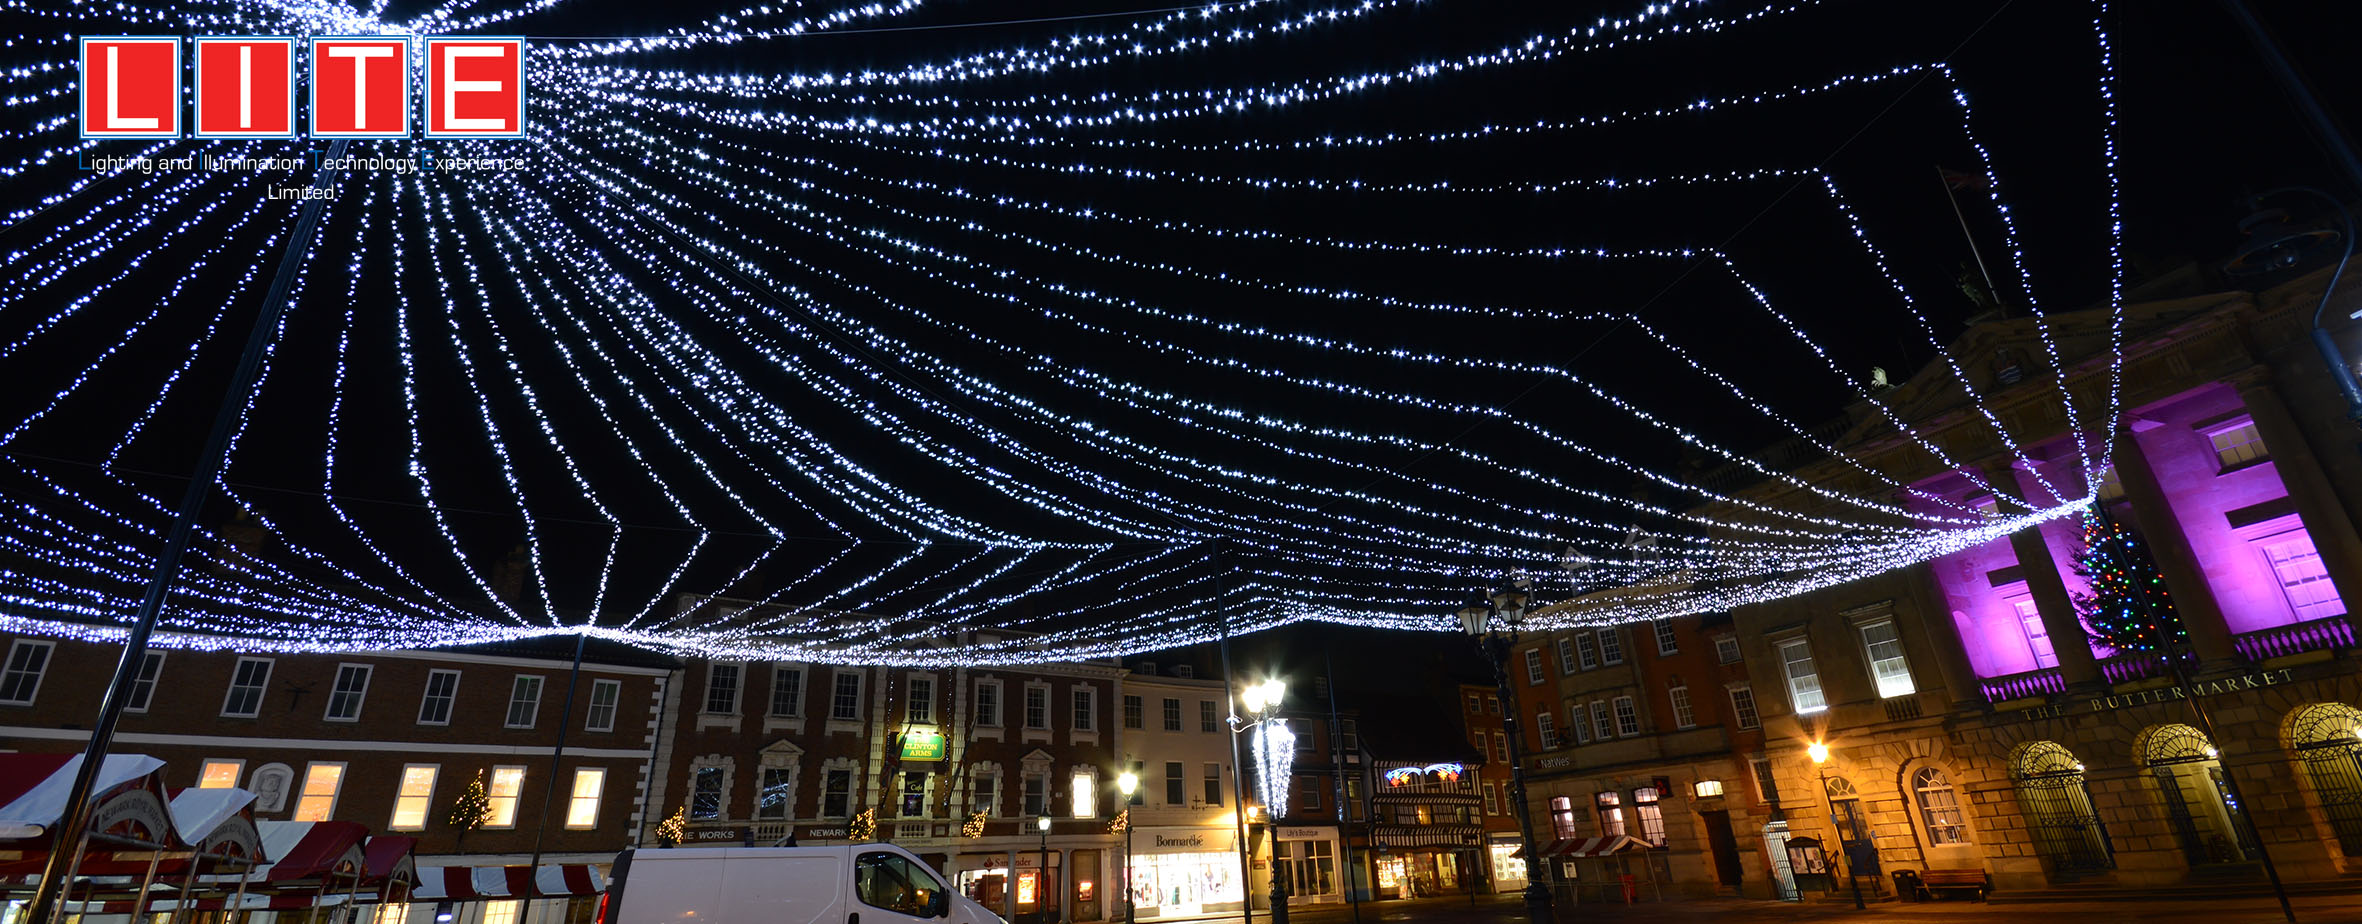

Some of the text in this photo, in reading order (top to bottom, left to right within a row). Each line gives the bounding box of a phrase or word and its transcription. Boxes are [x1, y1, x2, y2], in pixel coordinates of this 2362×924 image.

[2021, 704, 2066, 721] THE
[903, 743, 938, 751] CLINTON
[698, 831, 735, 840] WORKS
[809, 829, 847, 838] NEWARK
[1299, 829, 1319, 837] Boutique
[1156, 834, 1204, 848] Bonmarché
[994, 857, 1032, 867] Sannder
